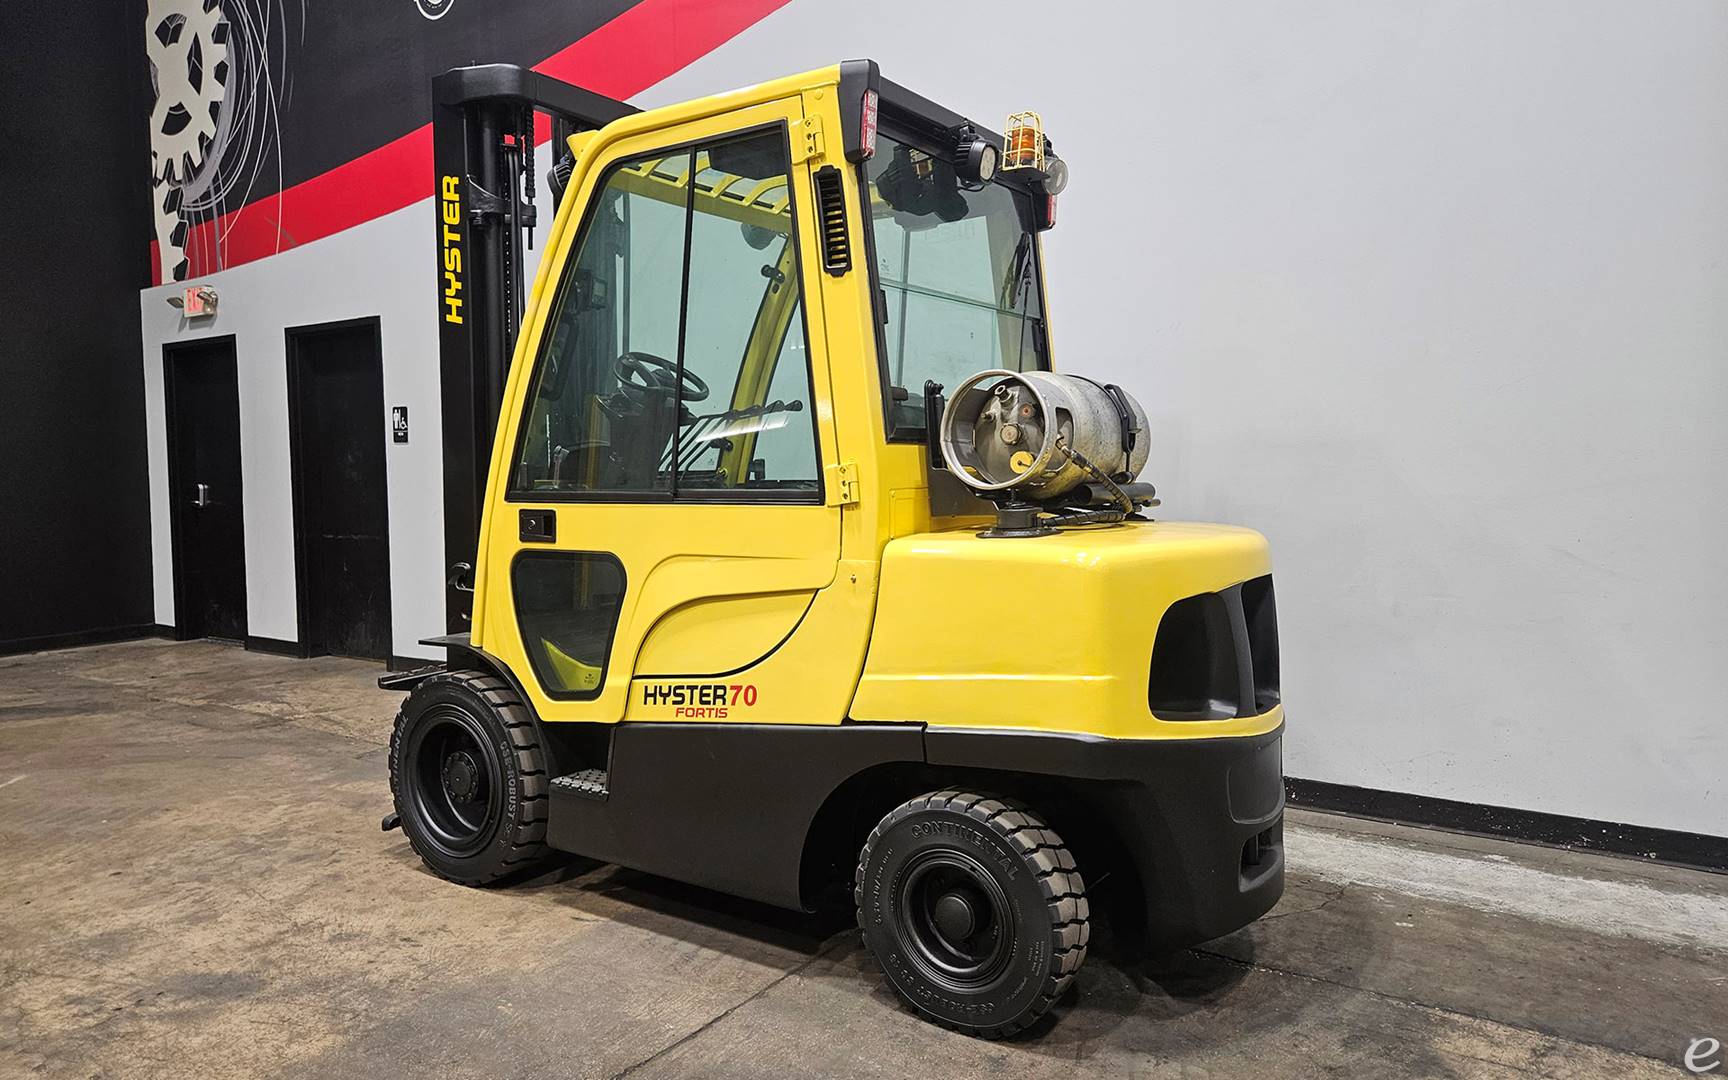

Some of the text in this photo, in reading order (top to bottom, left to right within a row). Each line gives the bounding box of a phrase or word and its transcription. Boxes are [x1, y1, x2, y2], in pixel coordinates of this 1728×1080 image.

[442, 175, 463, 325] HYSTER
[675, 707, 728, 718] FORTIS
[911, 820, 1019, 881] CONTINENTAL
